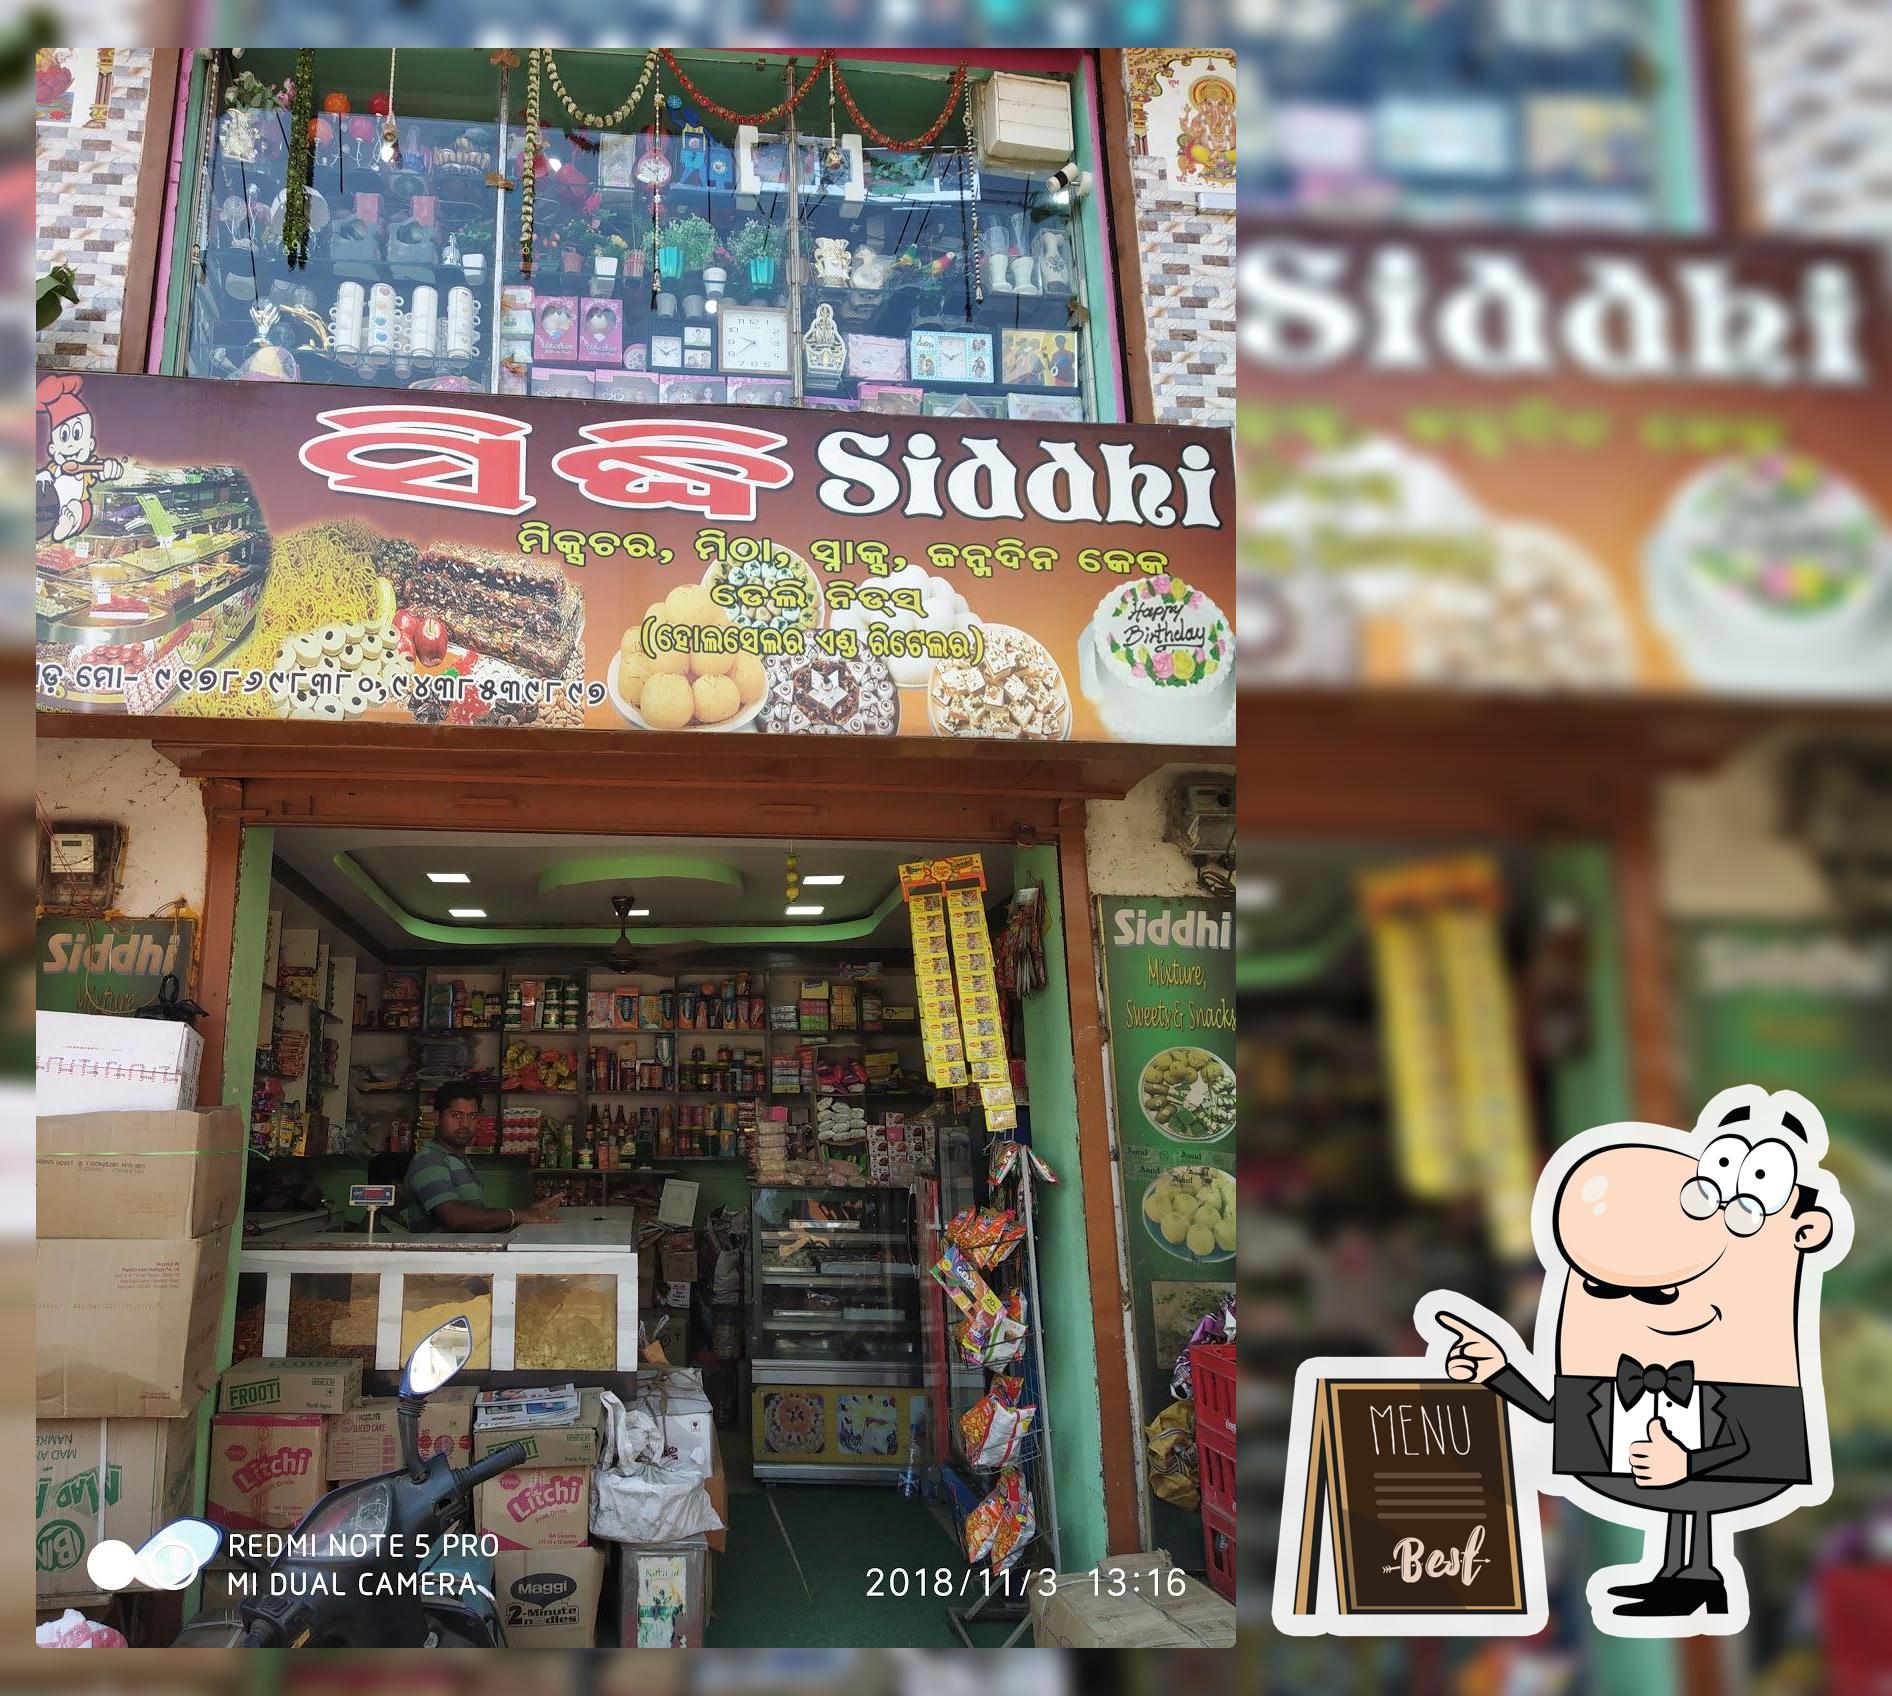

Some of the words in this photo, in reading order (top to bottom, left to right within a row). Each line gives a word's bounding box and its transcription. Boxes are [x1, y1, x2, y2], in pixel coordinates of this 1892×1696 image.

[816, 431, 1222, 528] Siddhi
[695, 529, 789, 568] ମିଠା,
[927, 538, 1059, 577] ଜନ୍ମଦିନ
[1128, 602, 1184, 622] Happy
[1122, 618, 1205, 652] Birthday
[1114, 908, 1232, 948] Siddhi
[43, 933, 180, 975] Siddhi
[1148, 955, 1206, 989] Mixture,
[1126, 999, 1171, 1030] Sweets
[1173, 1001, 1184, 1029] &
[1189, 999, 1236, 1031] Snacks
[229, 1381, 281, 1407] FROOTI
[51, 1449, 77, 1460] MAD
[236, 1450, 308, 1491] Litchi
[511, 1480, 580, 1520] Litchi
[518, 1581, 568, 1595] Maggi
